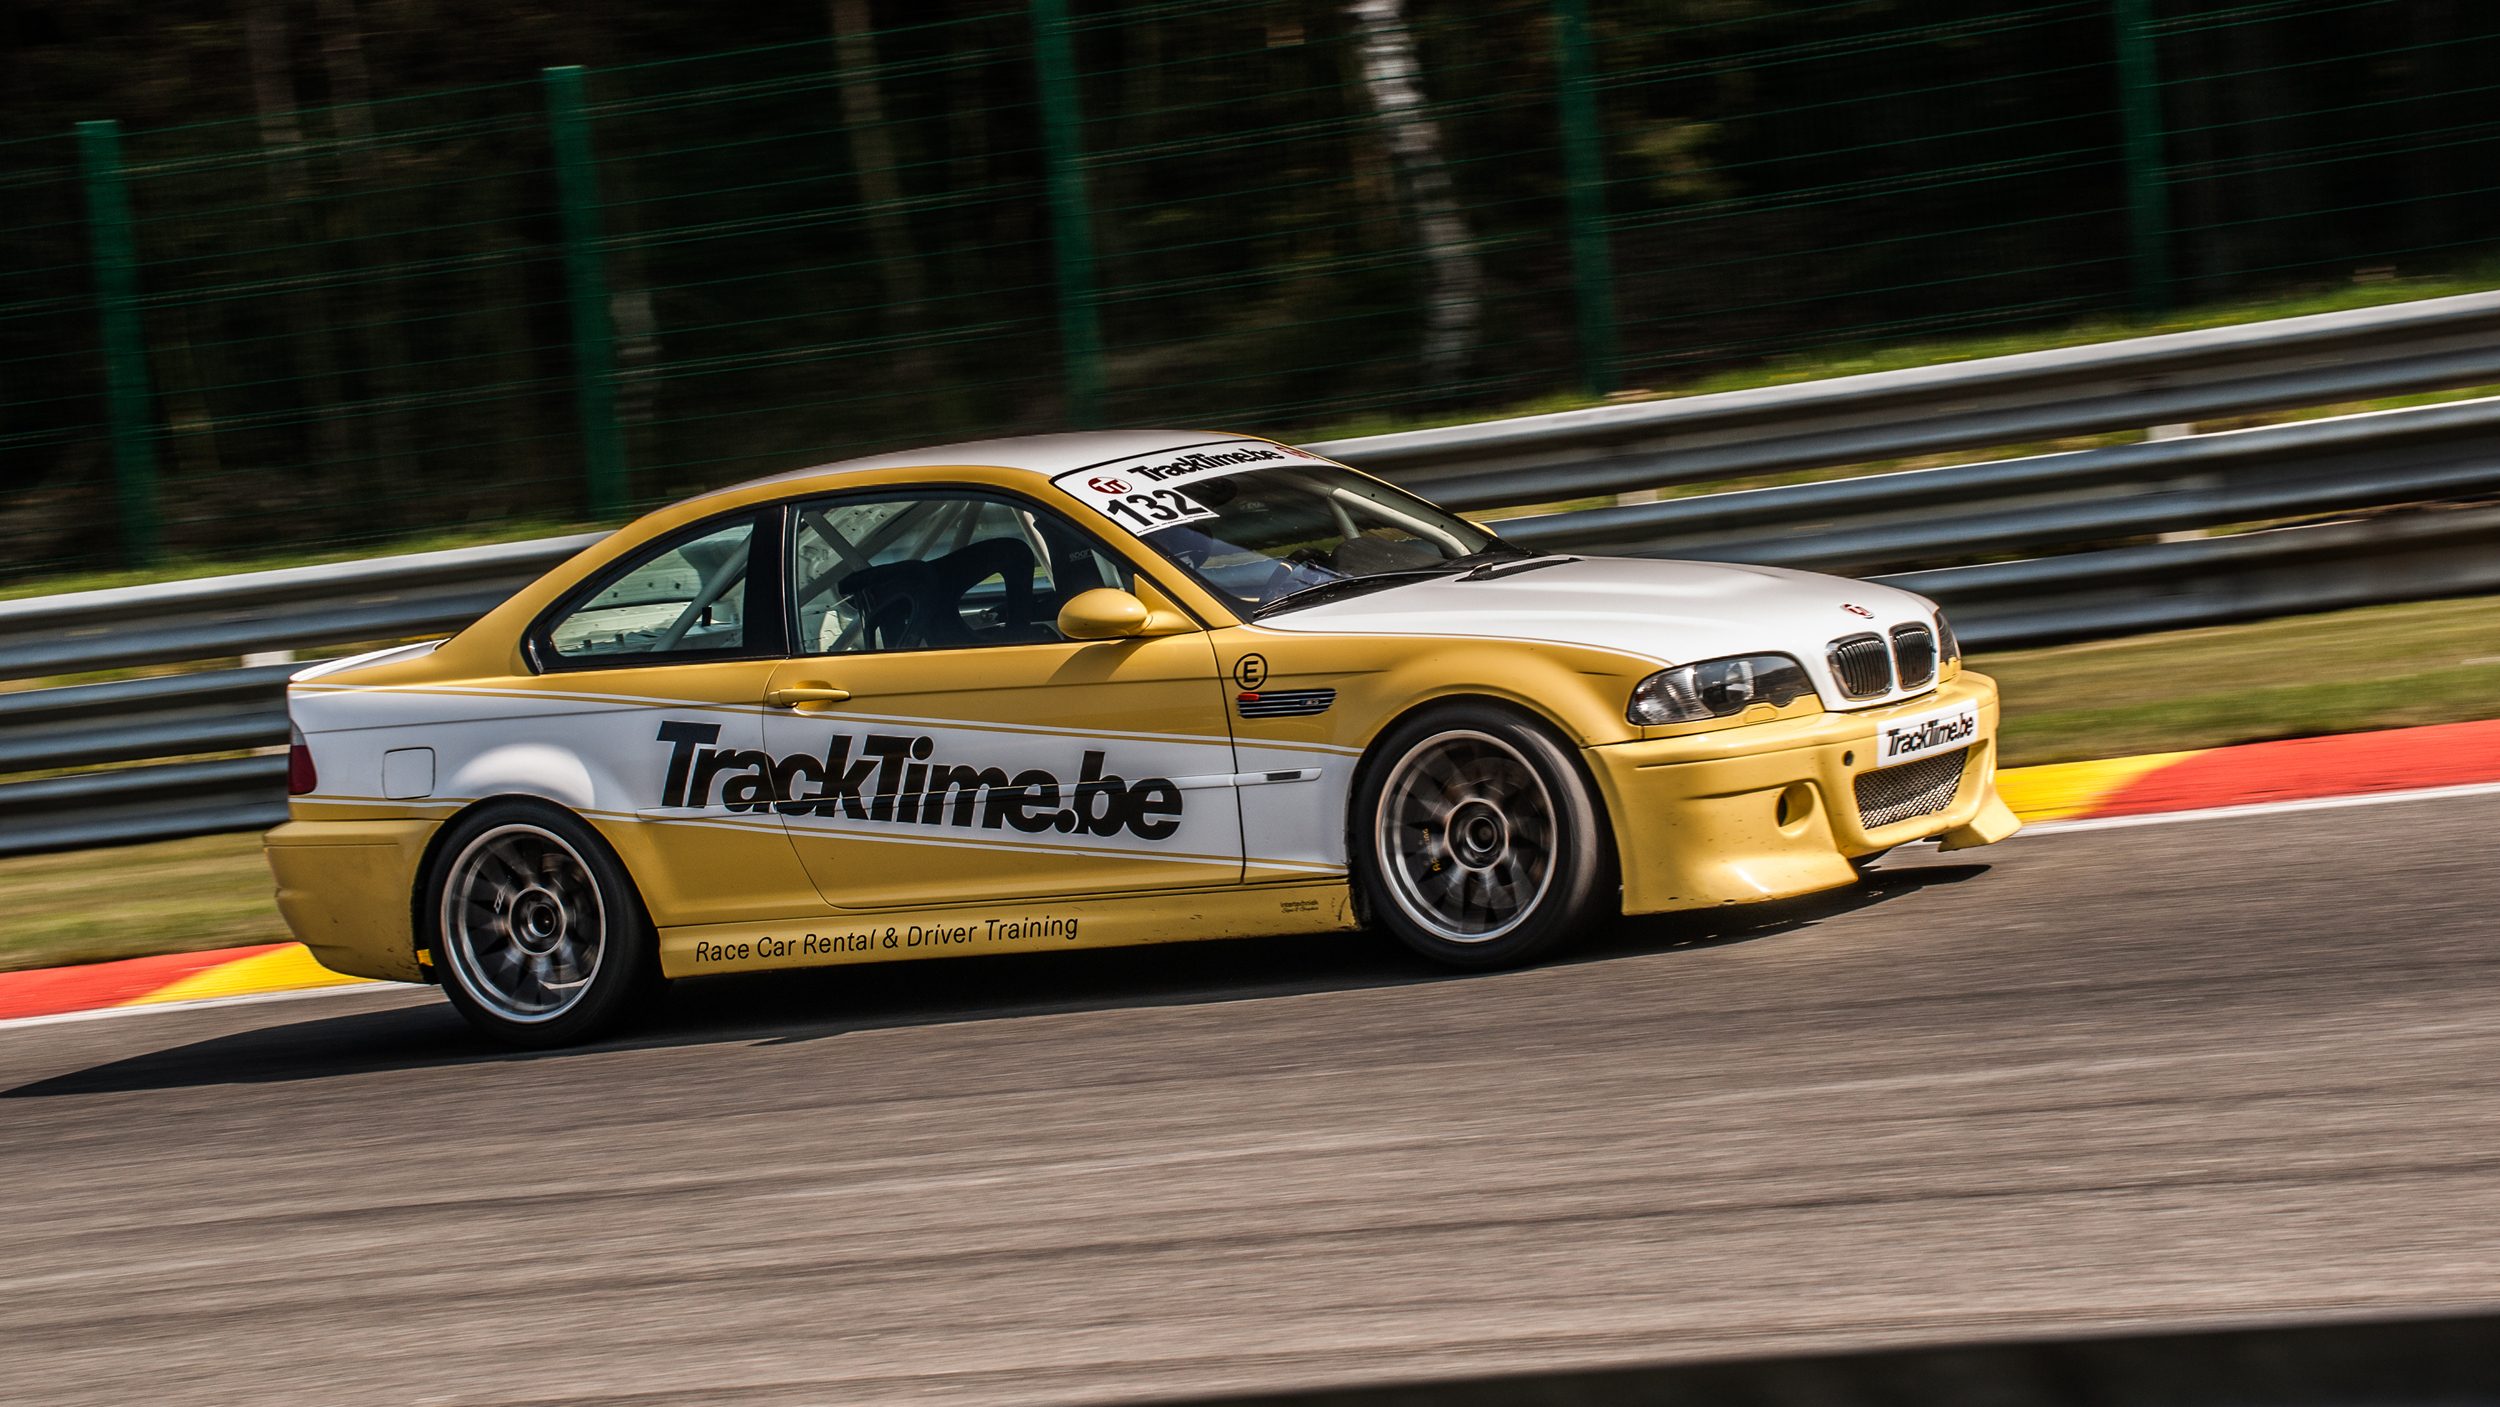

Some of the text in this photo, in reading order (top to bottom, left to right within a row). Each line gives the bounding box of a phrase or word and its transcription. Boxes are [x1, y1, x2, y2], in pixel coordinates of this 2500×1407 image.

[1127, 449, 1285, 481] TrackTime.be
[1106, 489, 1209, 528] 132
[1243, 660, 1259, 683] E
[1887, 712, 1973, 757] TrackTime.be
[656, 720, 1184, 841] TrackTime.be
[695, 914, 1079, 963] Race Car Rental & Driver Training
